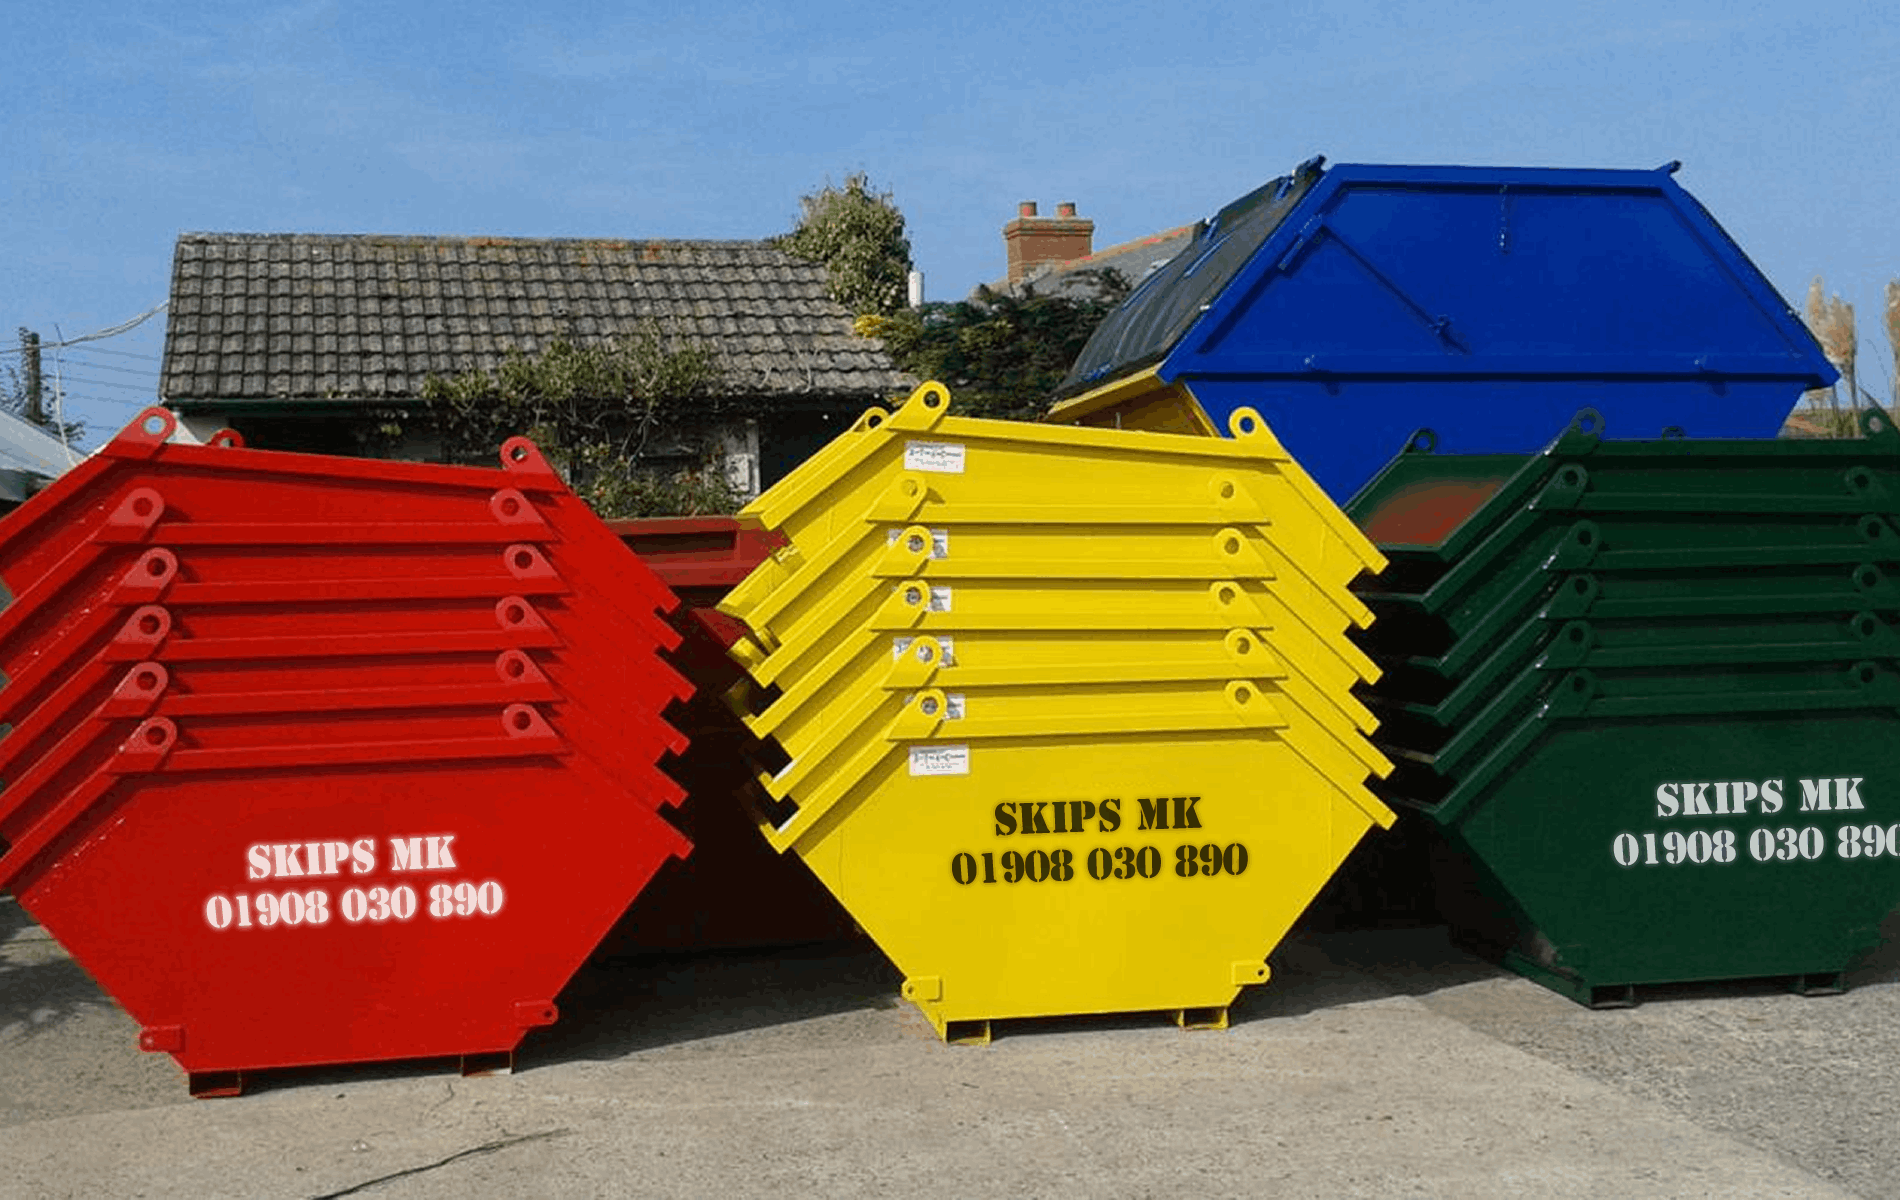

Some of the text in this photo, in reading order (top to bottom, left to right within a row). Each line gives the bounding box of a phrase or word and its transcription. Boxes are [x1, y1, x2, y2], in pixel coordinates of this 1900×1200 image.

[994, 796, 1203, 837] SKIPS MK
[1656, 777, 1865, 817] SKIPS MK
[248, 835, 457, 880] SKIPS MK
[951, 842, 1249, 885] 01908 030 890
[1612, 829, 1737, 866] 01908
[1749, 826, 1825, 862] 030
[206, 881, 503, 929] 01908 030 890
